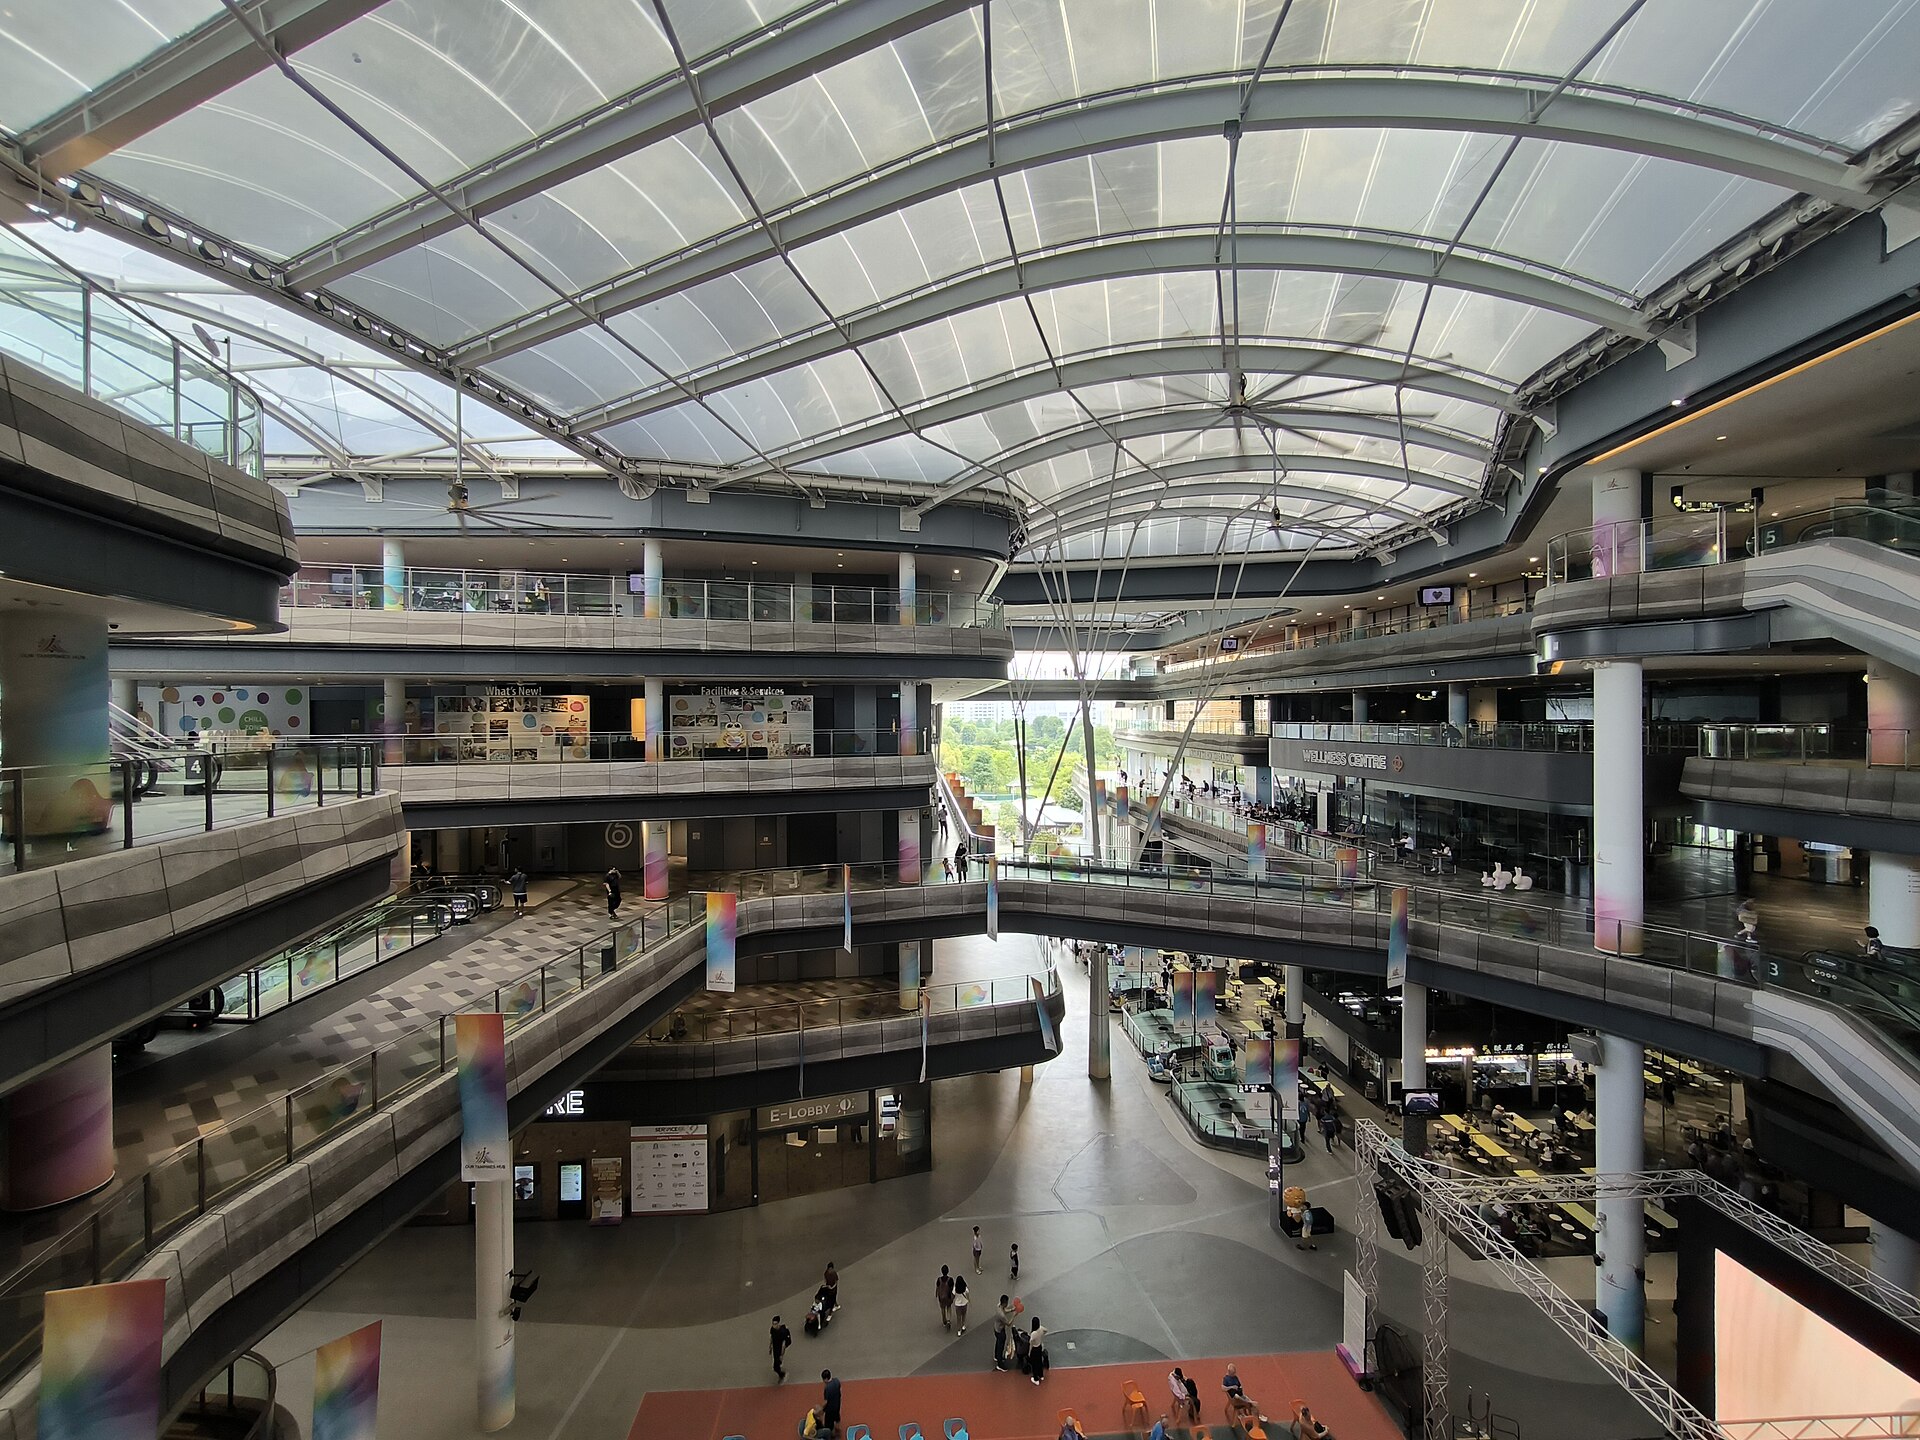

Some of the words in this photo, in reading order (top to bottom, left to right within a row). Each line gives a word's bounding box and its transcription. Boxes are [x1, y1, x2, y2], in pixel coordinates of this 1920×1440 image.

[1673, 495, 1682, 507] 5
[1766, 530, 1776, 544] 5
[485, 686, 517, 696] What's
[518, 686, 542, 696] New!
[701, 686, 740, 696] Facilities
[741, 687, 749, 695] &
[749, 686, 785, 696] Services
[1302, 749, 1347, 766] WELLNESS
[1348, 752, 1387, 770] CENTRE
[190, 759, 202, 774] 4
[481, 889, 488, 900] 3
[1769, 962, 1779, 976] 3
